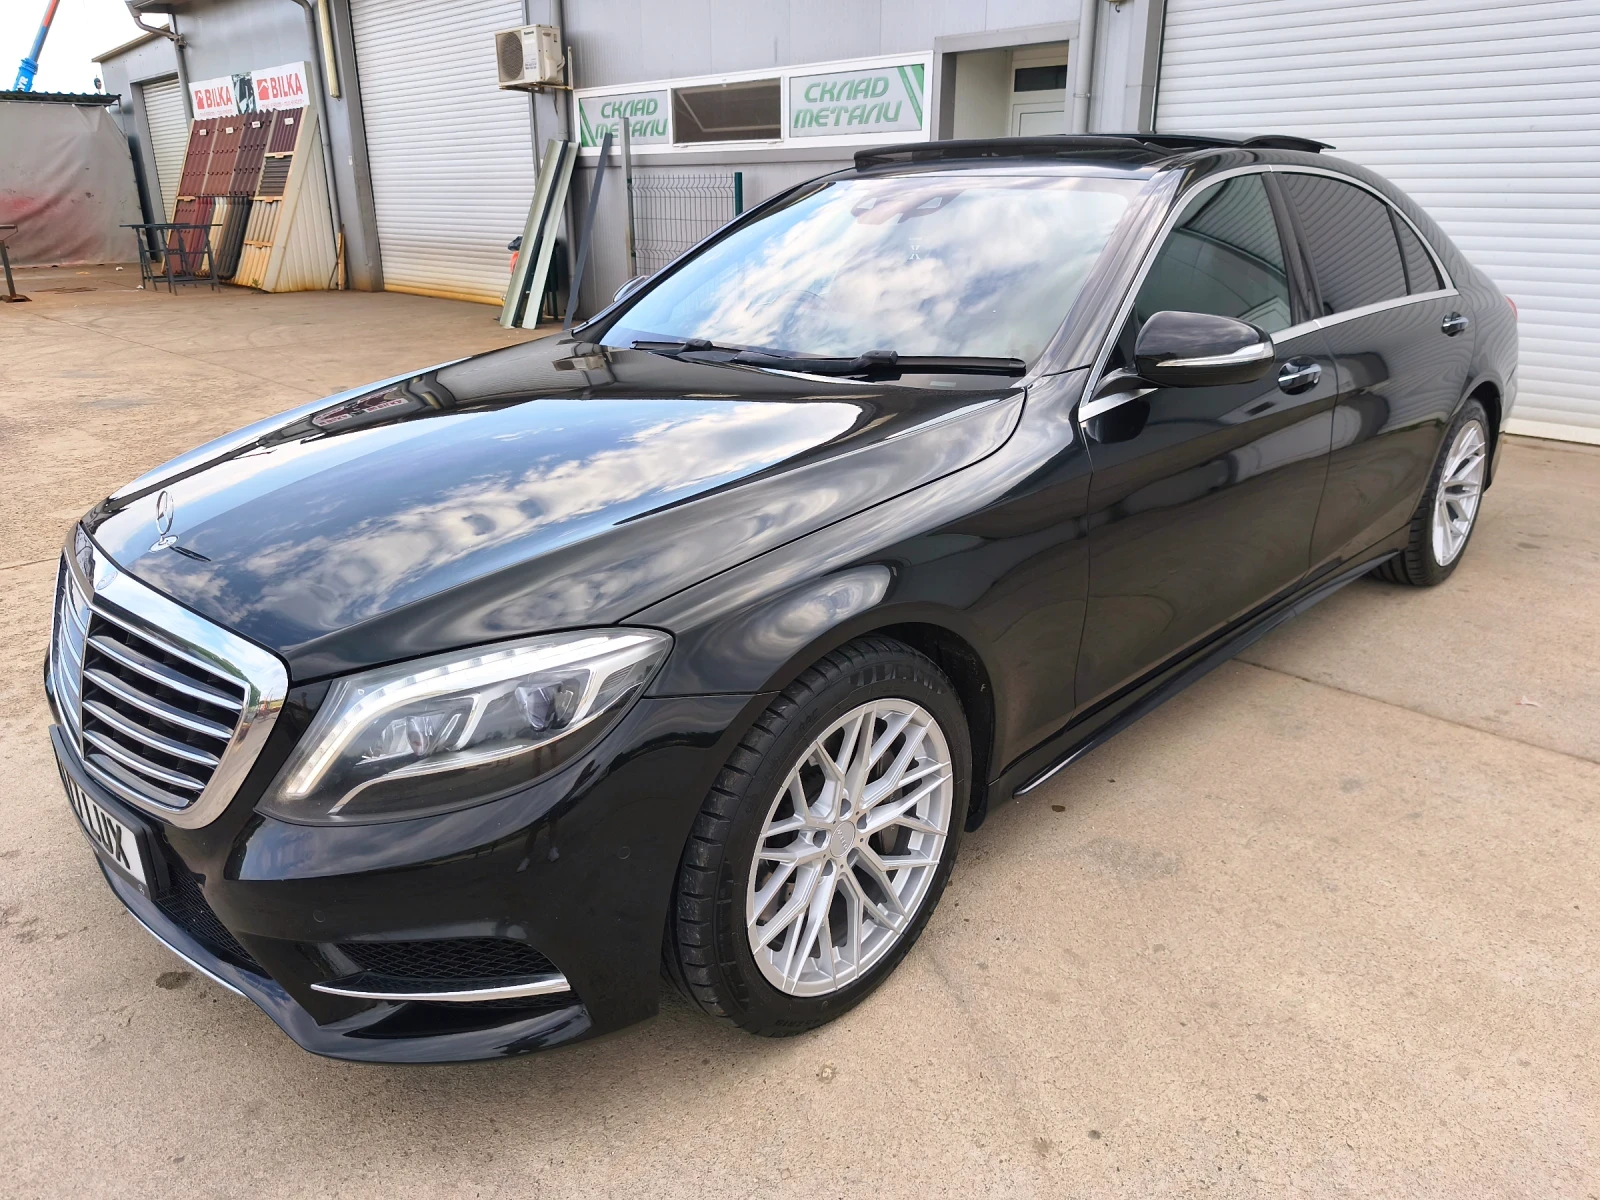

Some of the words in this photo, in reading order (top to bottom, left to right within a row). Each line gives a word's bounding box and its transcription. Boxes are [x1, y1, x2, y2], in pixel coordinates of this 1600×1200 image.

[204, 86, 233, 109] BILKA
[270, 73, 304, 98] BILKA
[804, 76, 890, 103] СКЛАД
[600, 98, 659, 119] СКЛАД
[793, 100, 903, 129] МЕТАЛИ
[595, 118, 668, 140] МЕАЛИ
[81, 791, 131, 871] LUX
